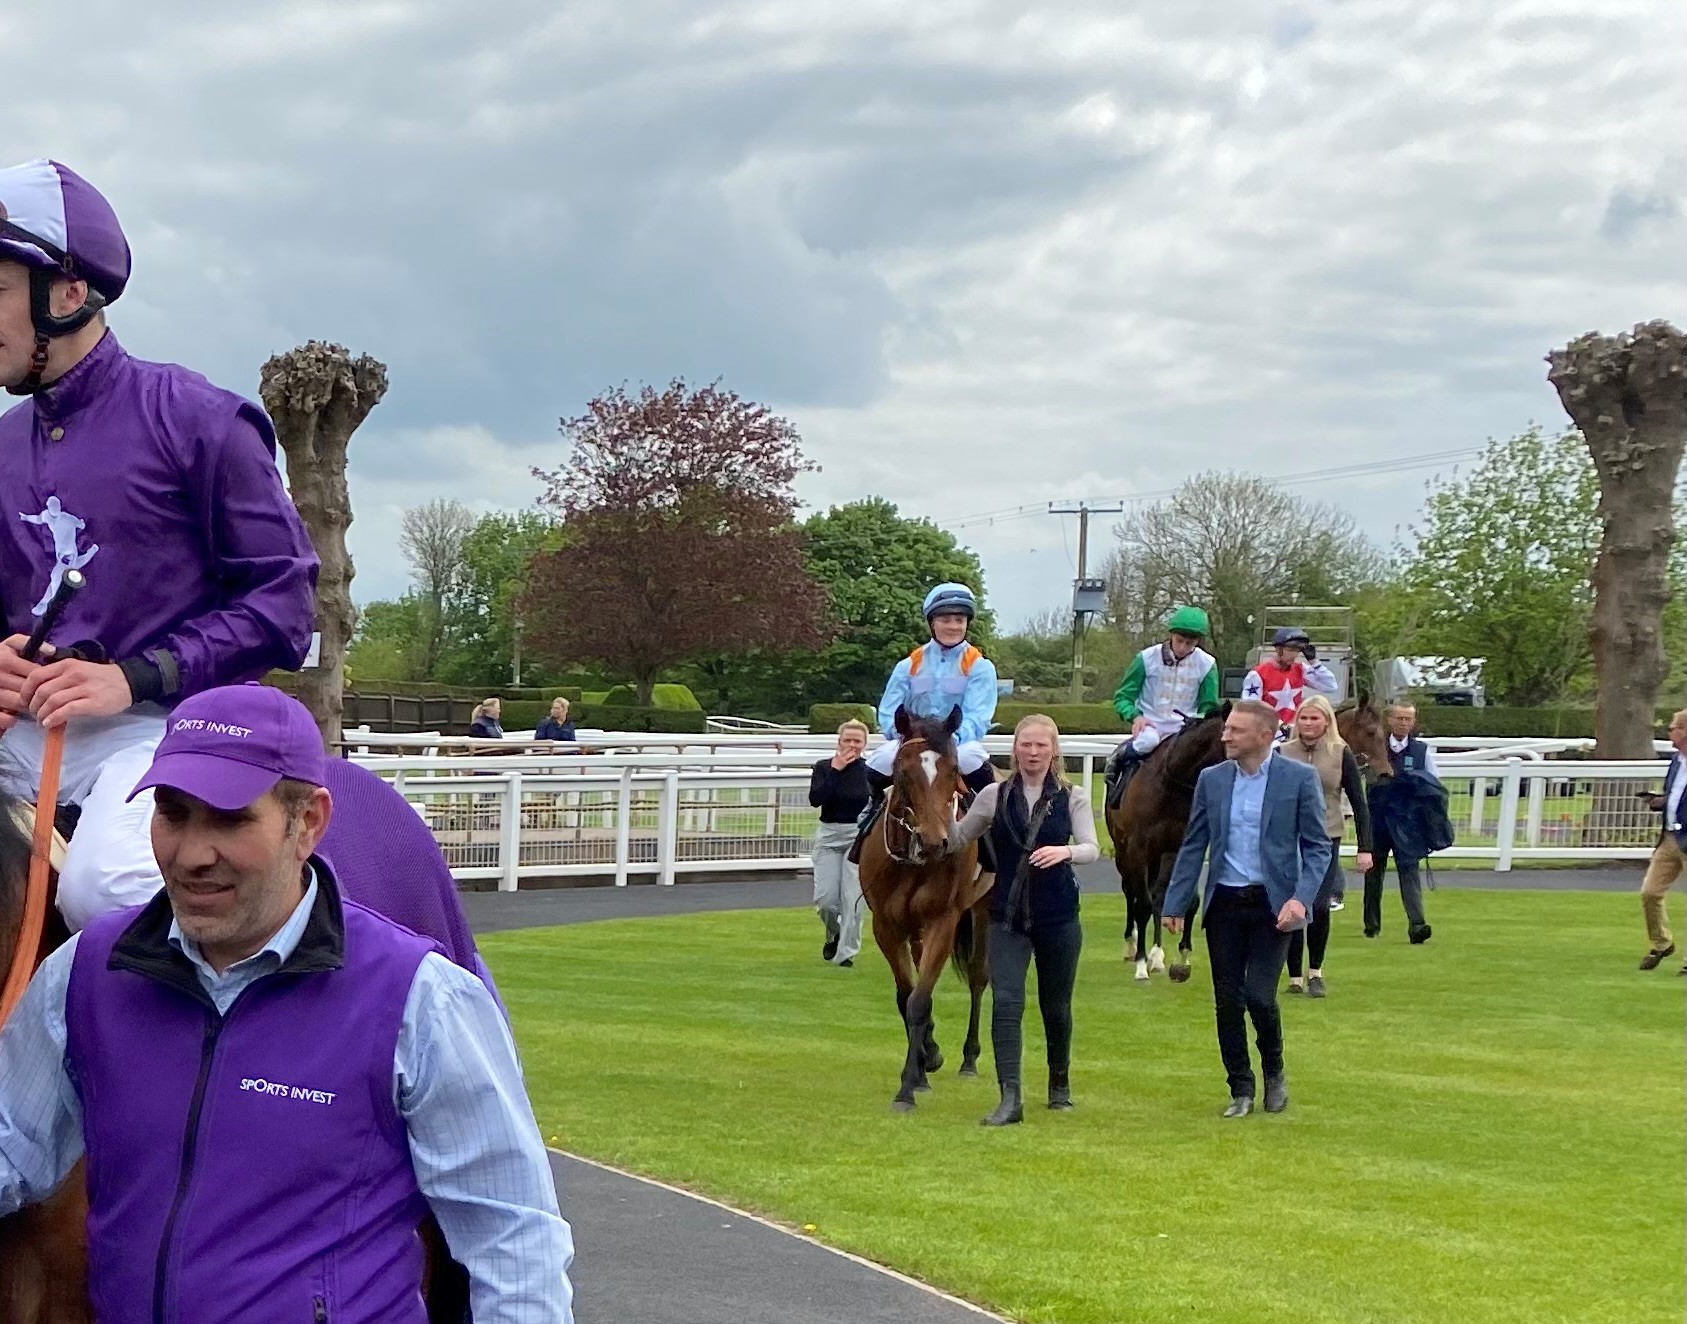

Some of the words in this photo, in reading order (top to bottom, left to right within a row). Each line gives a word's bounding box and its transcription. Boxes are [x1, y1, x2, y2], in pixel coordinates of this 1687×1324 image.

[206, 721, 253, 739] INVEST
[239, 1078, 289, 1097] SPORTS
[290, 1086, 336, 1105] INVEST
